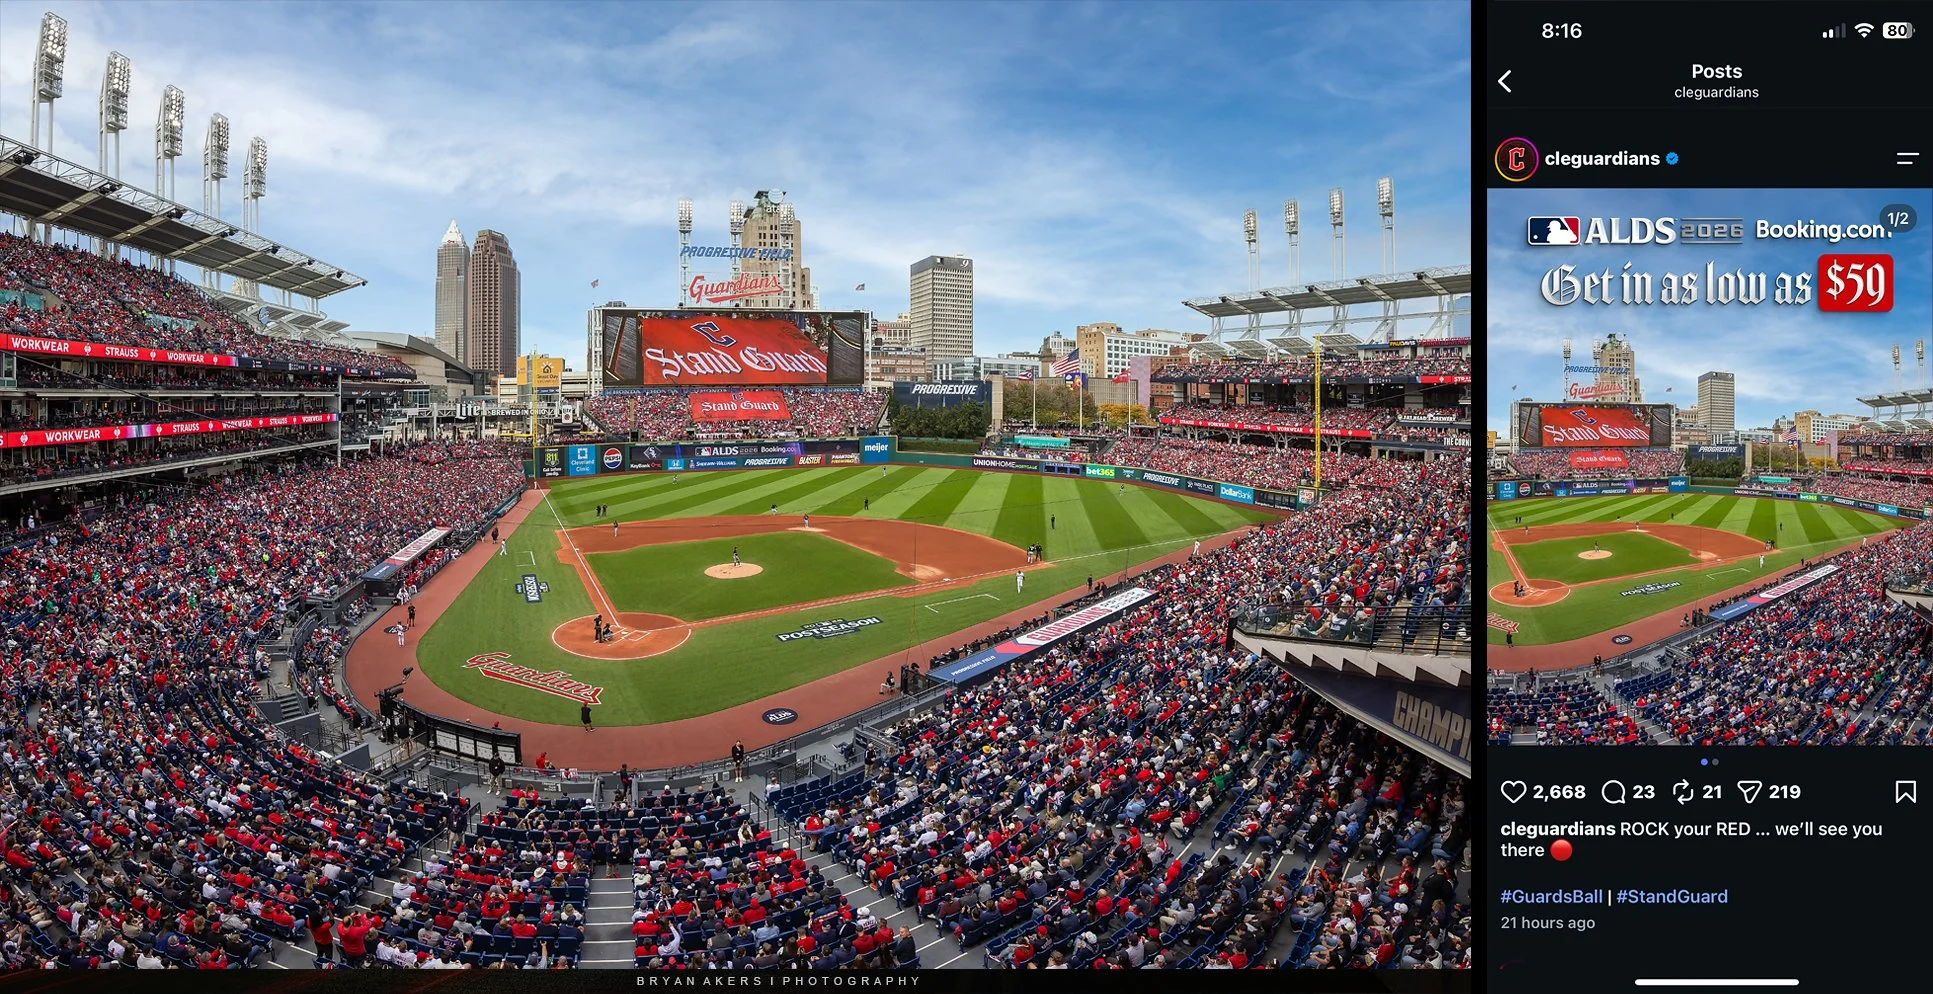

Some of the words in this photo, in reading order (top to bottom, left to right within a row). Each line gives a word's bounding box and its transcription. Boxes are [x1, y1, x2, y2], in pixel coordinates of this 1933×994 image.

[1542, 23, 1583, 39] 8:16
[1887, 24, 1908, 38] 80
[1691, 64, 1743, 79] Posts
[1674, 86, 1760, 101] cleguardians
[1544, 150, 1661, 169] cleguardians
[1887, 211, 1909, 227] 1/2
[1584, 216, 1677, 245] ALDS
[1680, 222, 1745, 240] 2026
[680, 246, 758, 259] PROGRESSIVE
[759, 247, 794, 260] FIELD
[689, 272, 785, 304] Guardians
[1540, 262, 1614, 307] Get
[1620, 260, 1656, 306] in
[1660, 271, 1699, 307] as
[1704, 260, 1768, 307] low
[1774, 271, 1813, 307] as
[1825, 259, 1886, 308] $59
[11, 337, 70, 352] WORKWEAR
[105, 346, 139, 358] STRAUSS
[166, 352, 204, 363] WORKWEAR
[645, 346, 743, 380] Stand
[739, 346, 828, 373] Guard
[1564, 366, 1610, 374] PROGRESSIVE
[911, 384, 979, 395] PROGRESSIVE
[456, 403, 481, 420] Lite
[701, 401, 738, 411] Stand
[740, 401, 779, 411] Guard
[45, 429, 101, 442] WORKWEAR
[172, 423, 200, 433] STRAUSS
[269, 417, 288, 425] STRAUSS
[864, 443, 889, 453] meijer
[1444, 437, 1454, 446] THE
[1454, 437, 1471, 447] CORN
[546, 452, 557, 462] 811
[712, 447, 739, 456] ALDS
[744, 458, 789, 466] PROGRESSIVE
[1086, 466, 1116, 477] bet365
[1143, 472, 1180, 486] PROGRESSIVE
[778, 617, 880, 641] POSTSEASON
[1027, 606, 1113, 642] GUARDIANS
[461, 652, 603, 704] Guardians
[1393, 690, 1471, 761] CHAMPI
[1532, 785, 1586, 802] 2,668
[1632, 785, 1656, 800] 23
[1702, 785, 1722, 800] 21
[1769, 785, 1801, 800] 219
[1500, 821, 1616, 840] cleguardians
[1620, 822, 1670, 837] ROCK
[1673, 825, 1712, 841] your
[1716, 822, 1751, 837] RED
[1818, 825, 1848, 838] see
[1852, 825, 1883, 841] you
[1500, 843, 1545, 858] there
[1500, 888, 1603, 905] #GuardsBall
[1616, 888, 1728, 905] #StandGuard
[1500, 916, 1518, 930] 21
[1521, 916, 1564, 930] hours
[1567, 919, 1596, 933] ago
